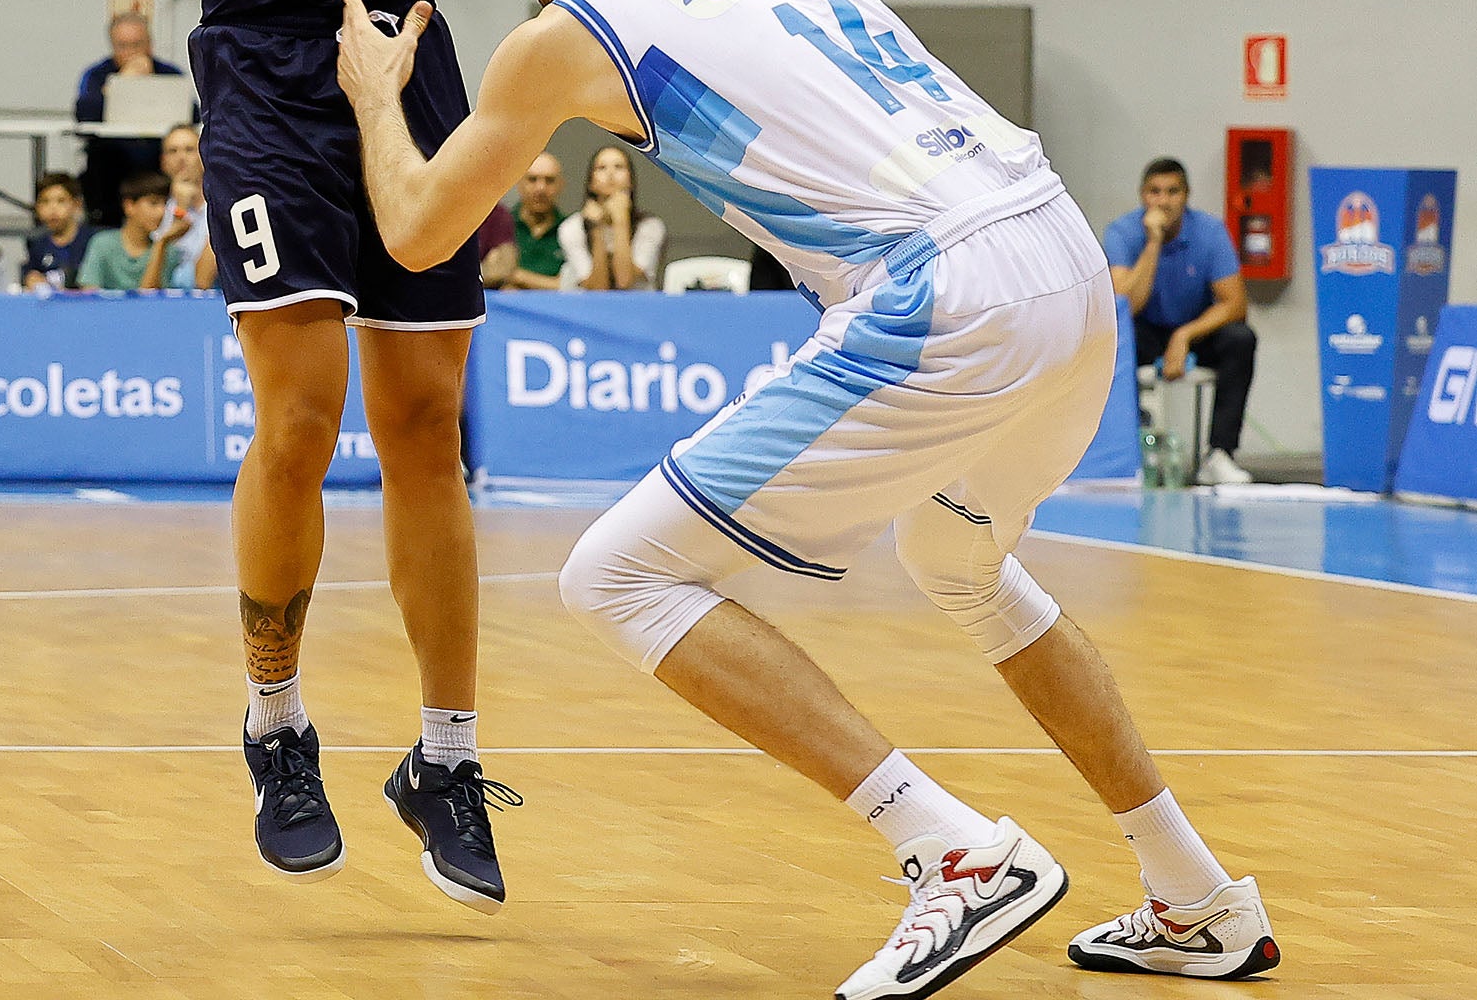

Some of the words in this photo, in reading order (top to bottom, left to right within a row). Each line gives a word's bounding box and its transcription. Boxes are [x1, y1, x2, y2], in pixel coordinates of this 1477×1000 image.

[915, 124, 976, 158] silb
[229, 193, 281, 284] 9
[505, 337, 728, 415] Diario
